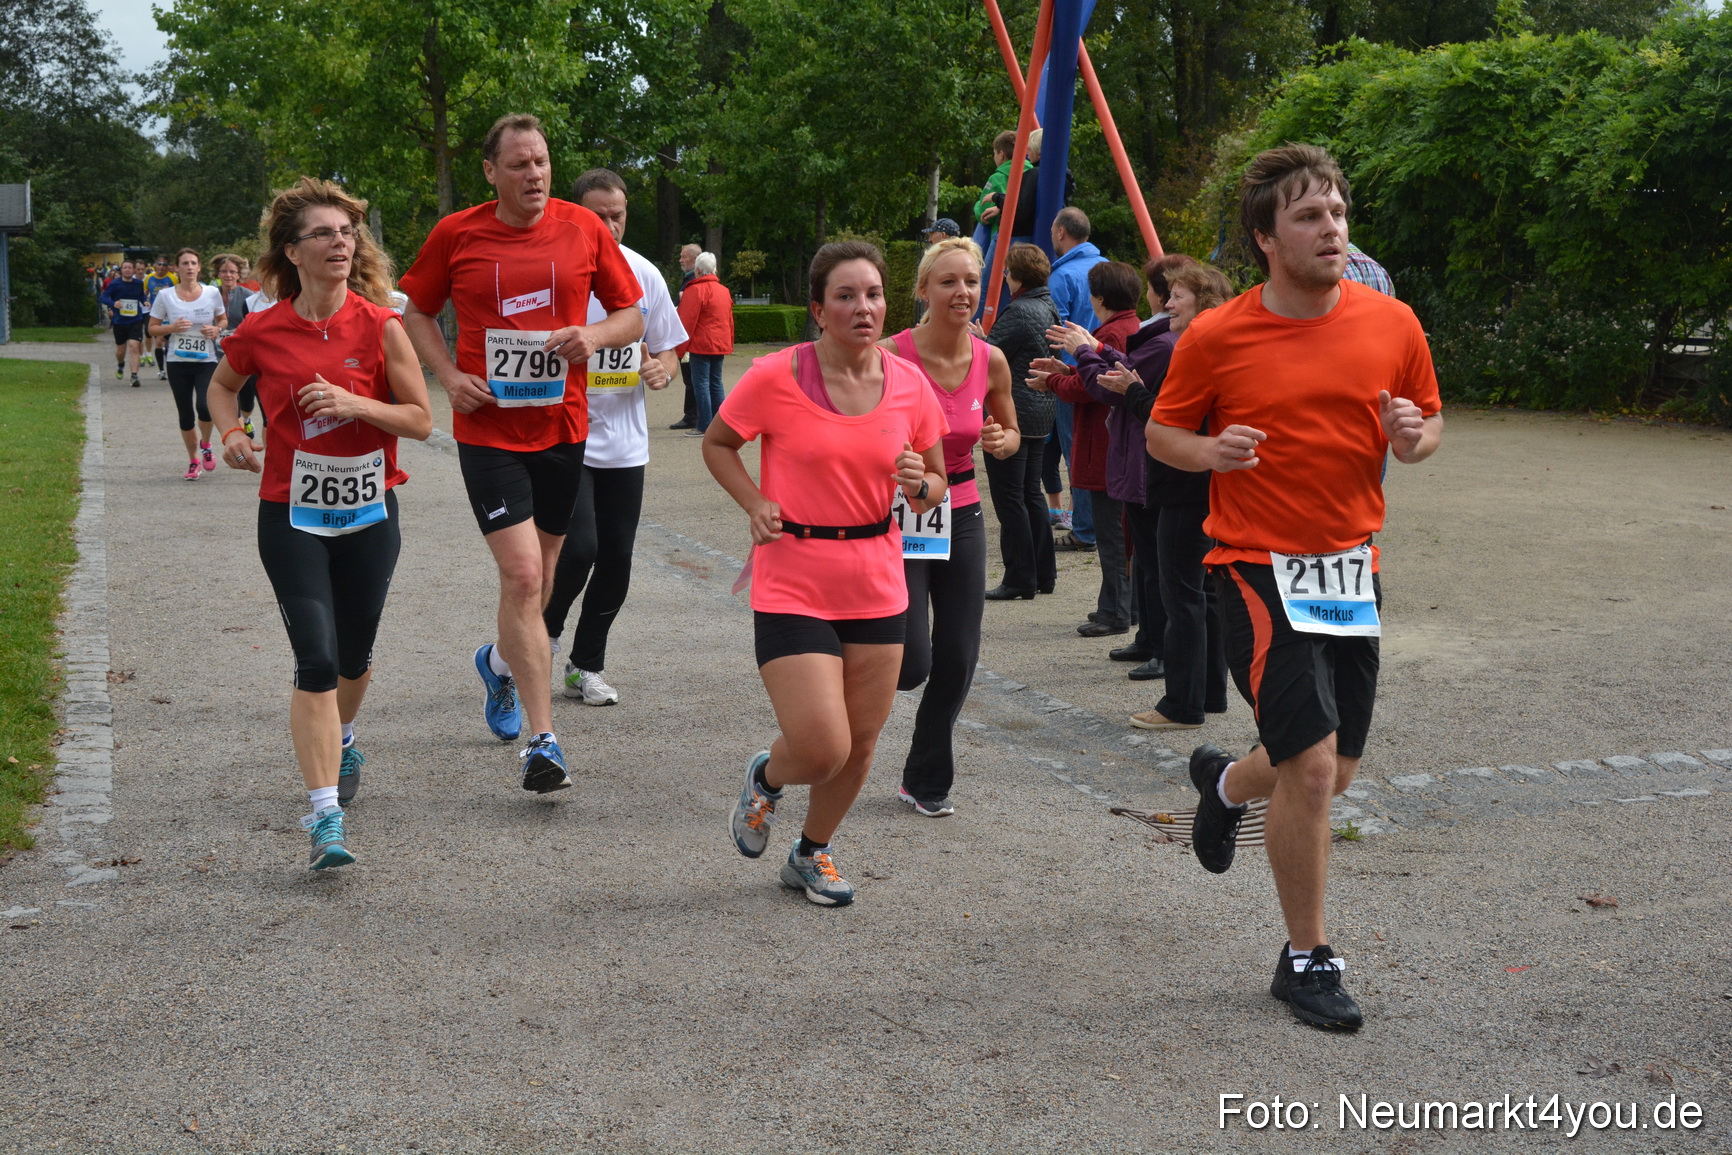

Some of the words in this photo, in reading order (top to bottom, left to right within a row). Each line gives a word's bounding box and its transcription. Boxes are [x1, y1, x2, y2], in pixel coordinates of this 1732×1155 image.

[515, 297, 538, 309] DEHN
[178, 338, 206, 352] 2548
[487, 336, 515, 346] PARTL
[516, 338, 548, 347] Neumar
[494, 349, 561, 378] 2796
[595, 346, 633, 370] 192
[594, 376, 628, 386] Gerhard
[504, 385, 547, 397] Michael
[317, 415, 339, 430] DEHN
[295, 458, 325, 472] PARTL
[327, 462, 370, 473] Neumarkt
[300, 472, 377, 506] 2635
[322, 512, 356, 527] Birgit
[893, 503, 944, 534] 114
[902, 540, 926, 552] drea
[286, 558, 364, 596] 2117
[1309, 605, 1354, 621] Markus
